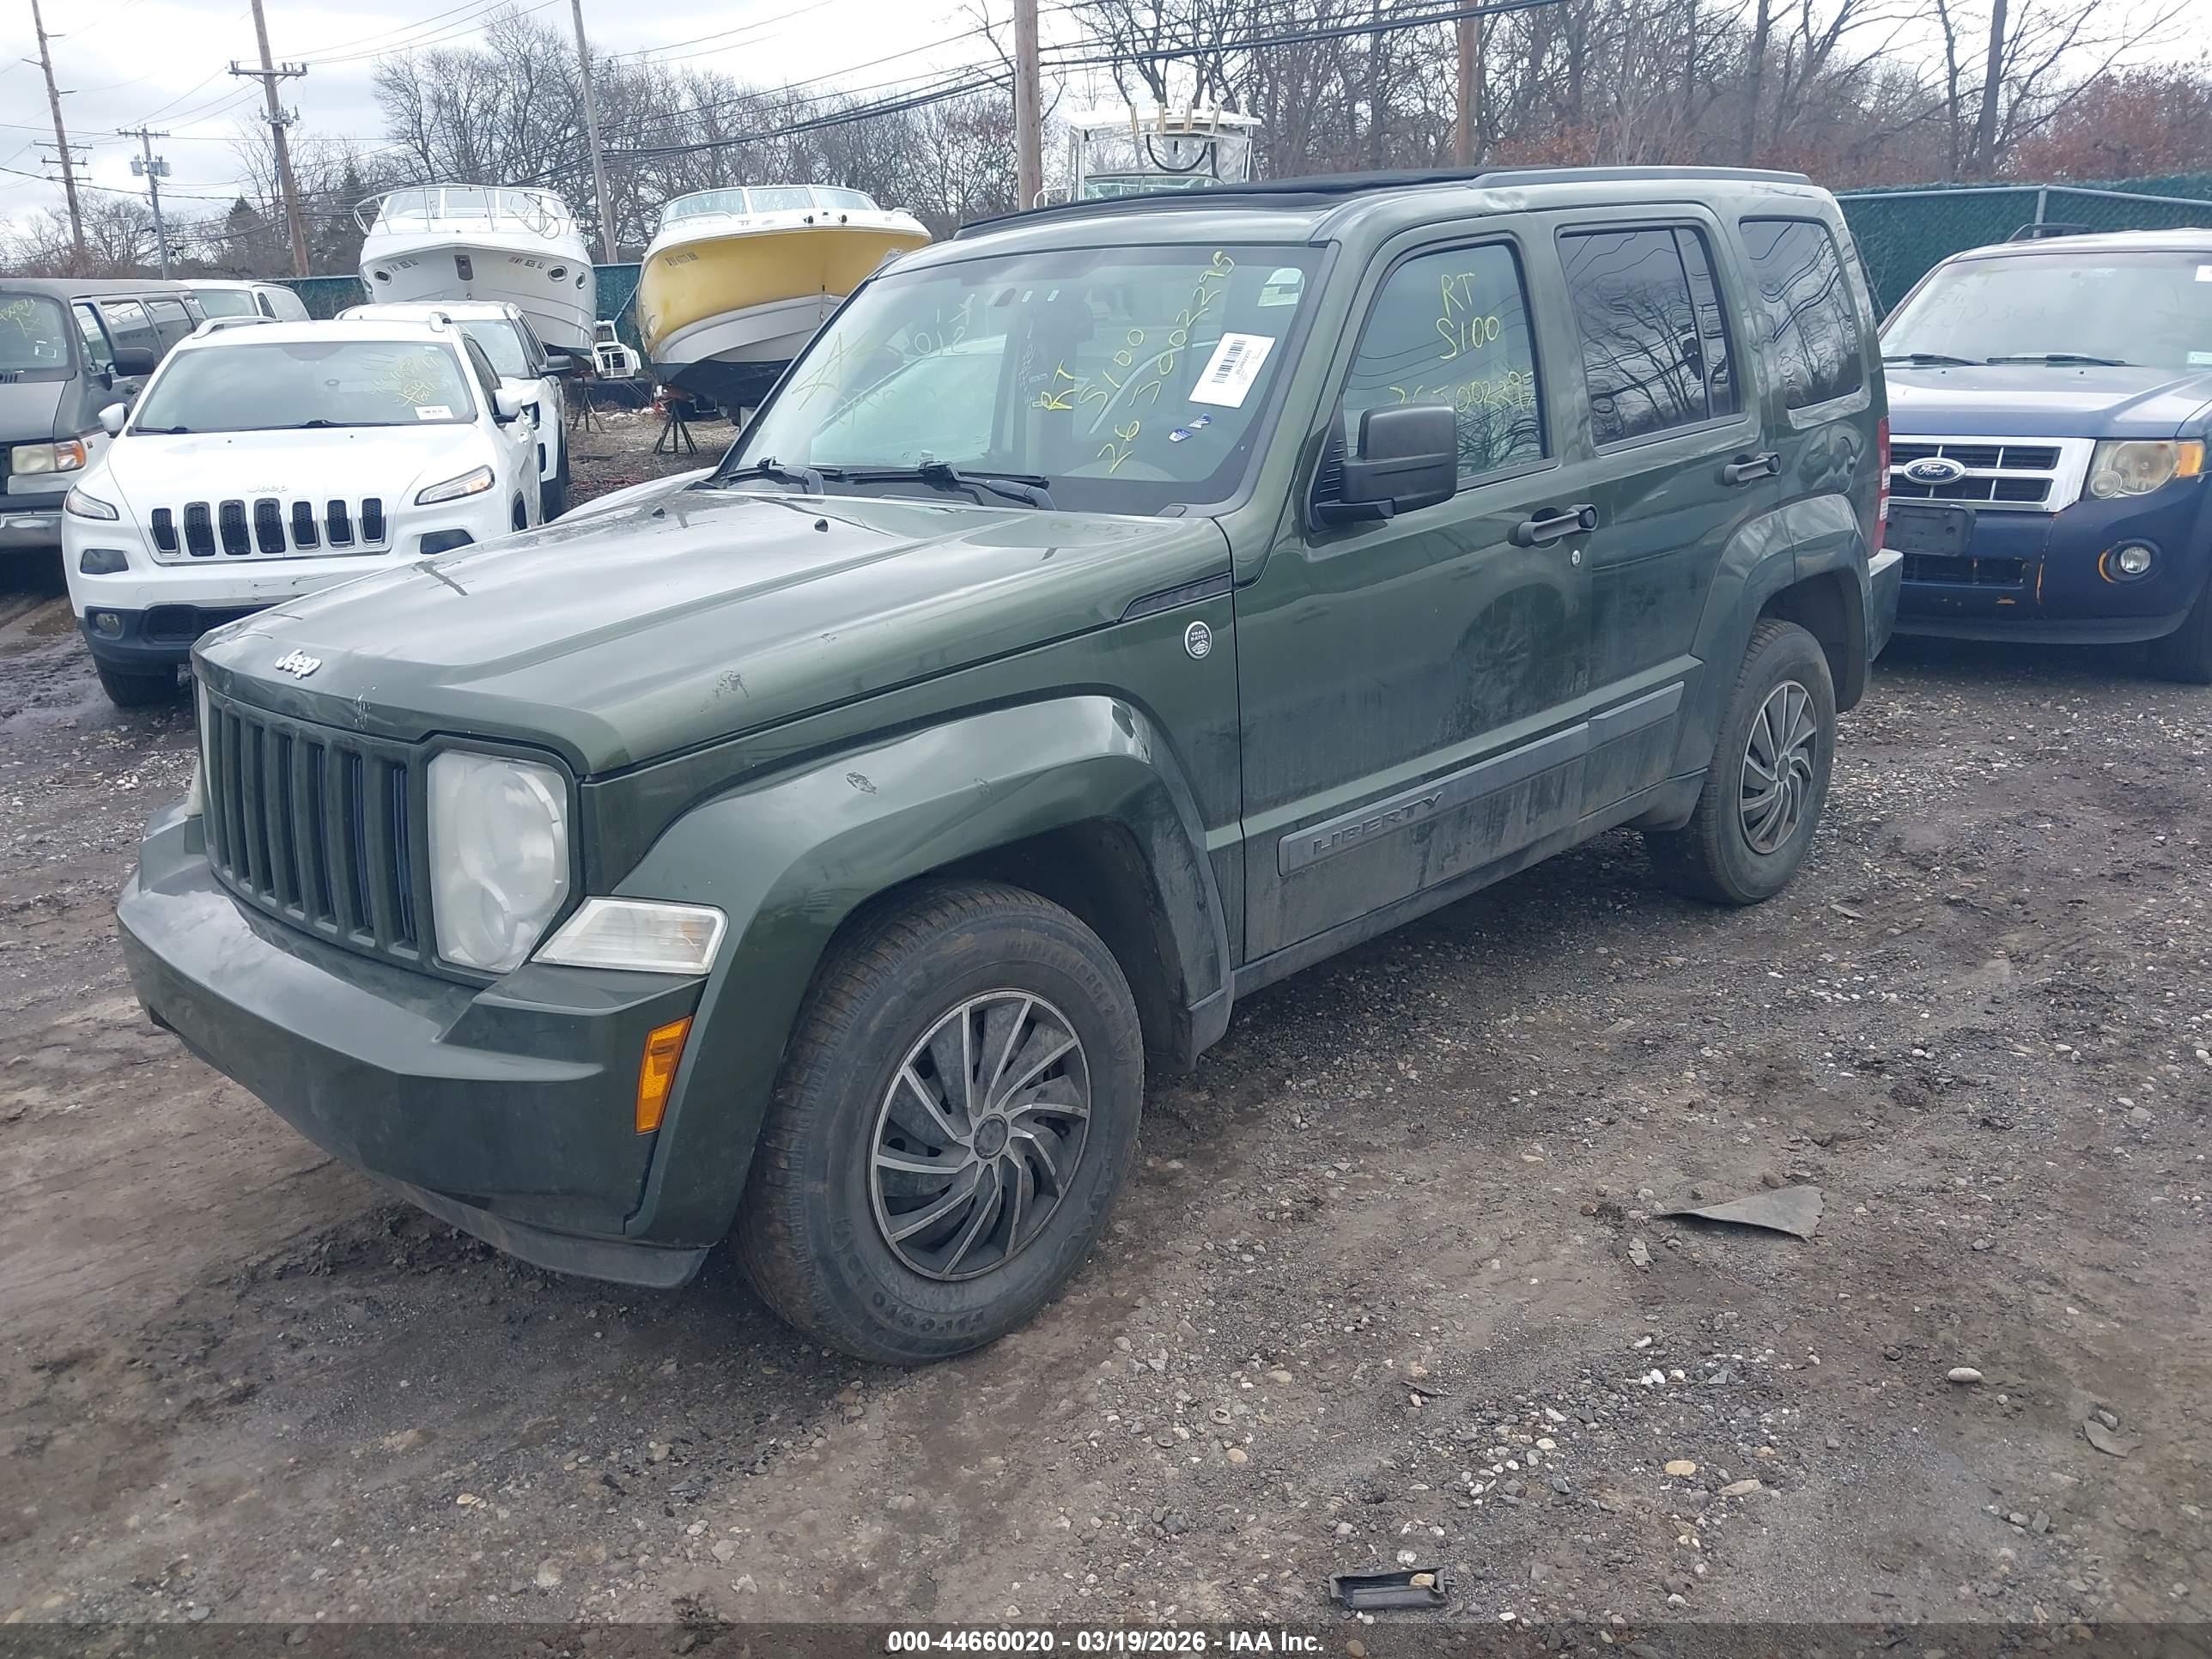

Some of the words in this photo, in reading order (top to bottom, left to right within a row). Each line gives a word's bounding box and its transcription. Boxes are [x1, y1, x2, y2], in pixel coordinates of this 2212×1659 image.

[1441, 271, 1476, 318] RT
[1436, 315, 1500, 360] S100
[1917, 464, 1948, 477] Ford
[1190, 629, 1206, 637] TRAIL
[274, 648, 323, 680] Jeep
[1312, 790, 1443, 855] LIBERTY
